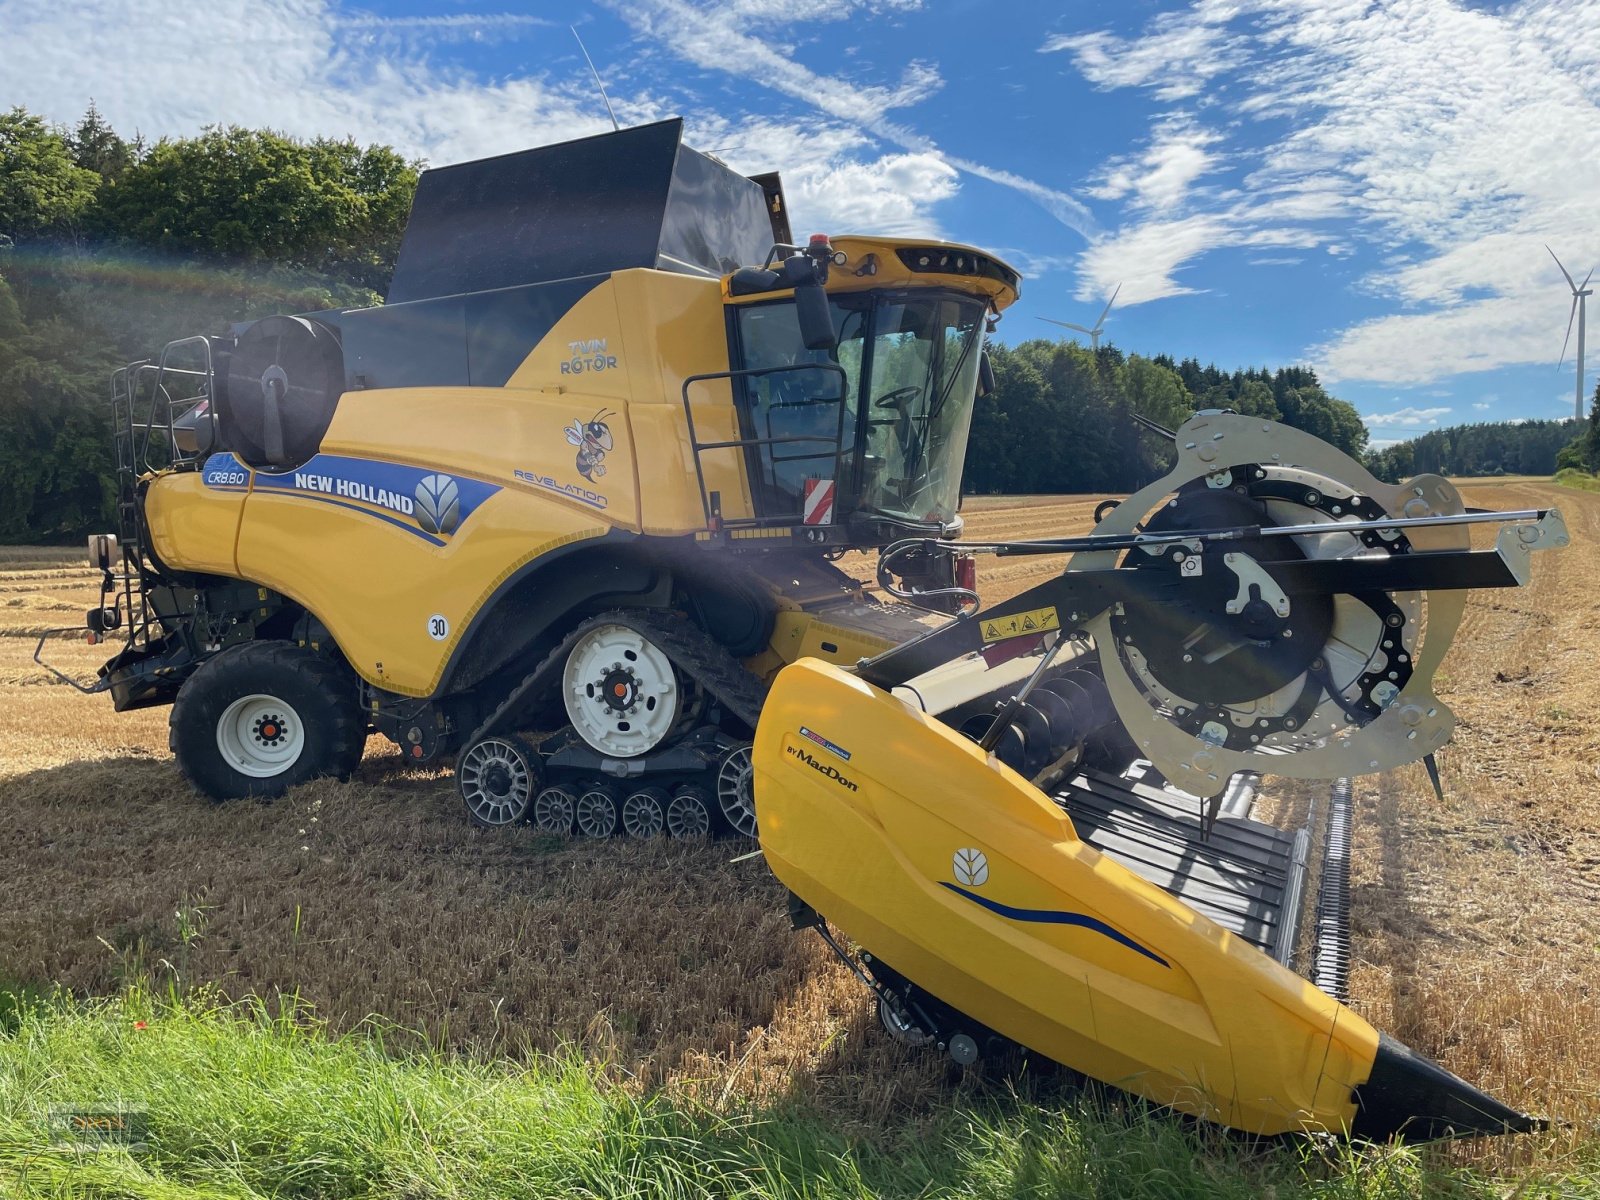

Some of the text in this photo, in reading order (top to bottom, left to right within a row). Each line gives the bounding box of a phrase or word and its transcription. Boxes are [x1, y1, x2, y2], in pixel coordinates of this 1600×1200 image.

[568, 338, 608, 355] TWIN
[560, 353, 618, 375] ROTOR
[208, 471, 245, 485] CR8.80
[513, 469, 608, 506] REVELATION
[295, 473, 414, 515] NEW HOLLAND
[431, 618, 445, 637] 30
[787, 746, 859, 793] BY MacDon
